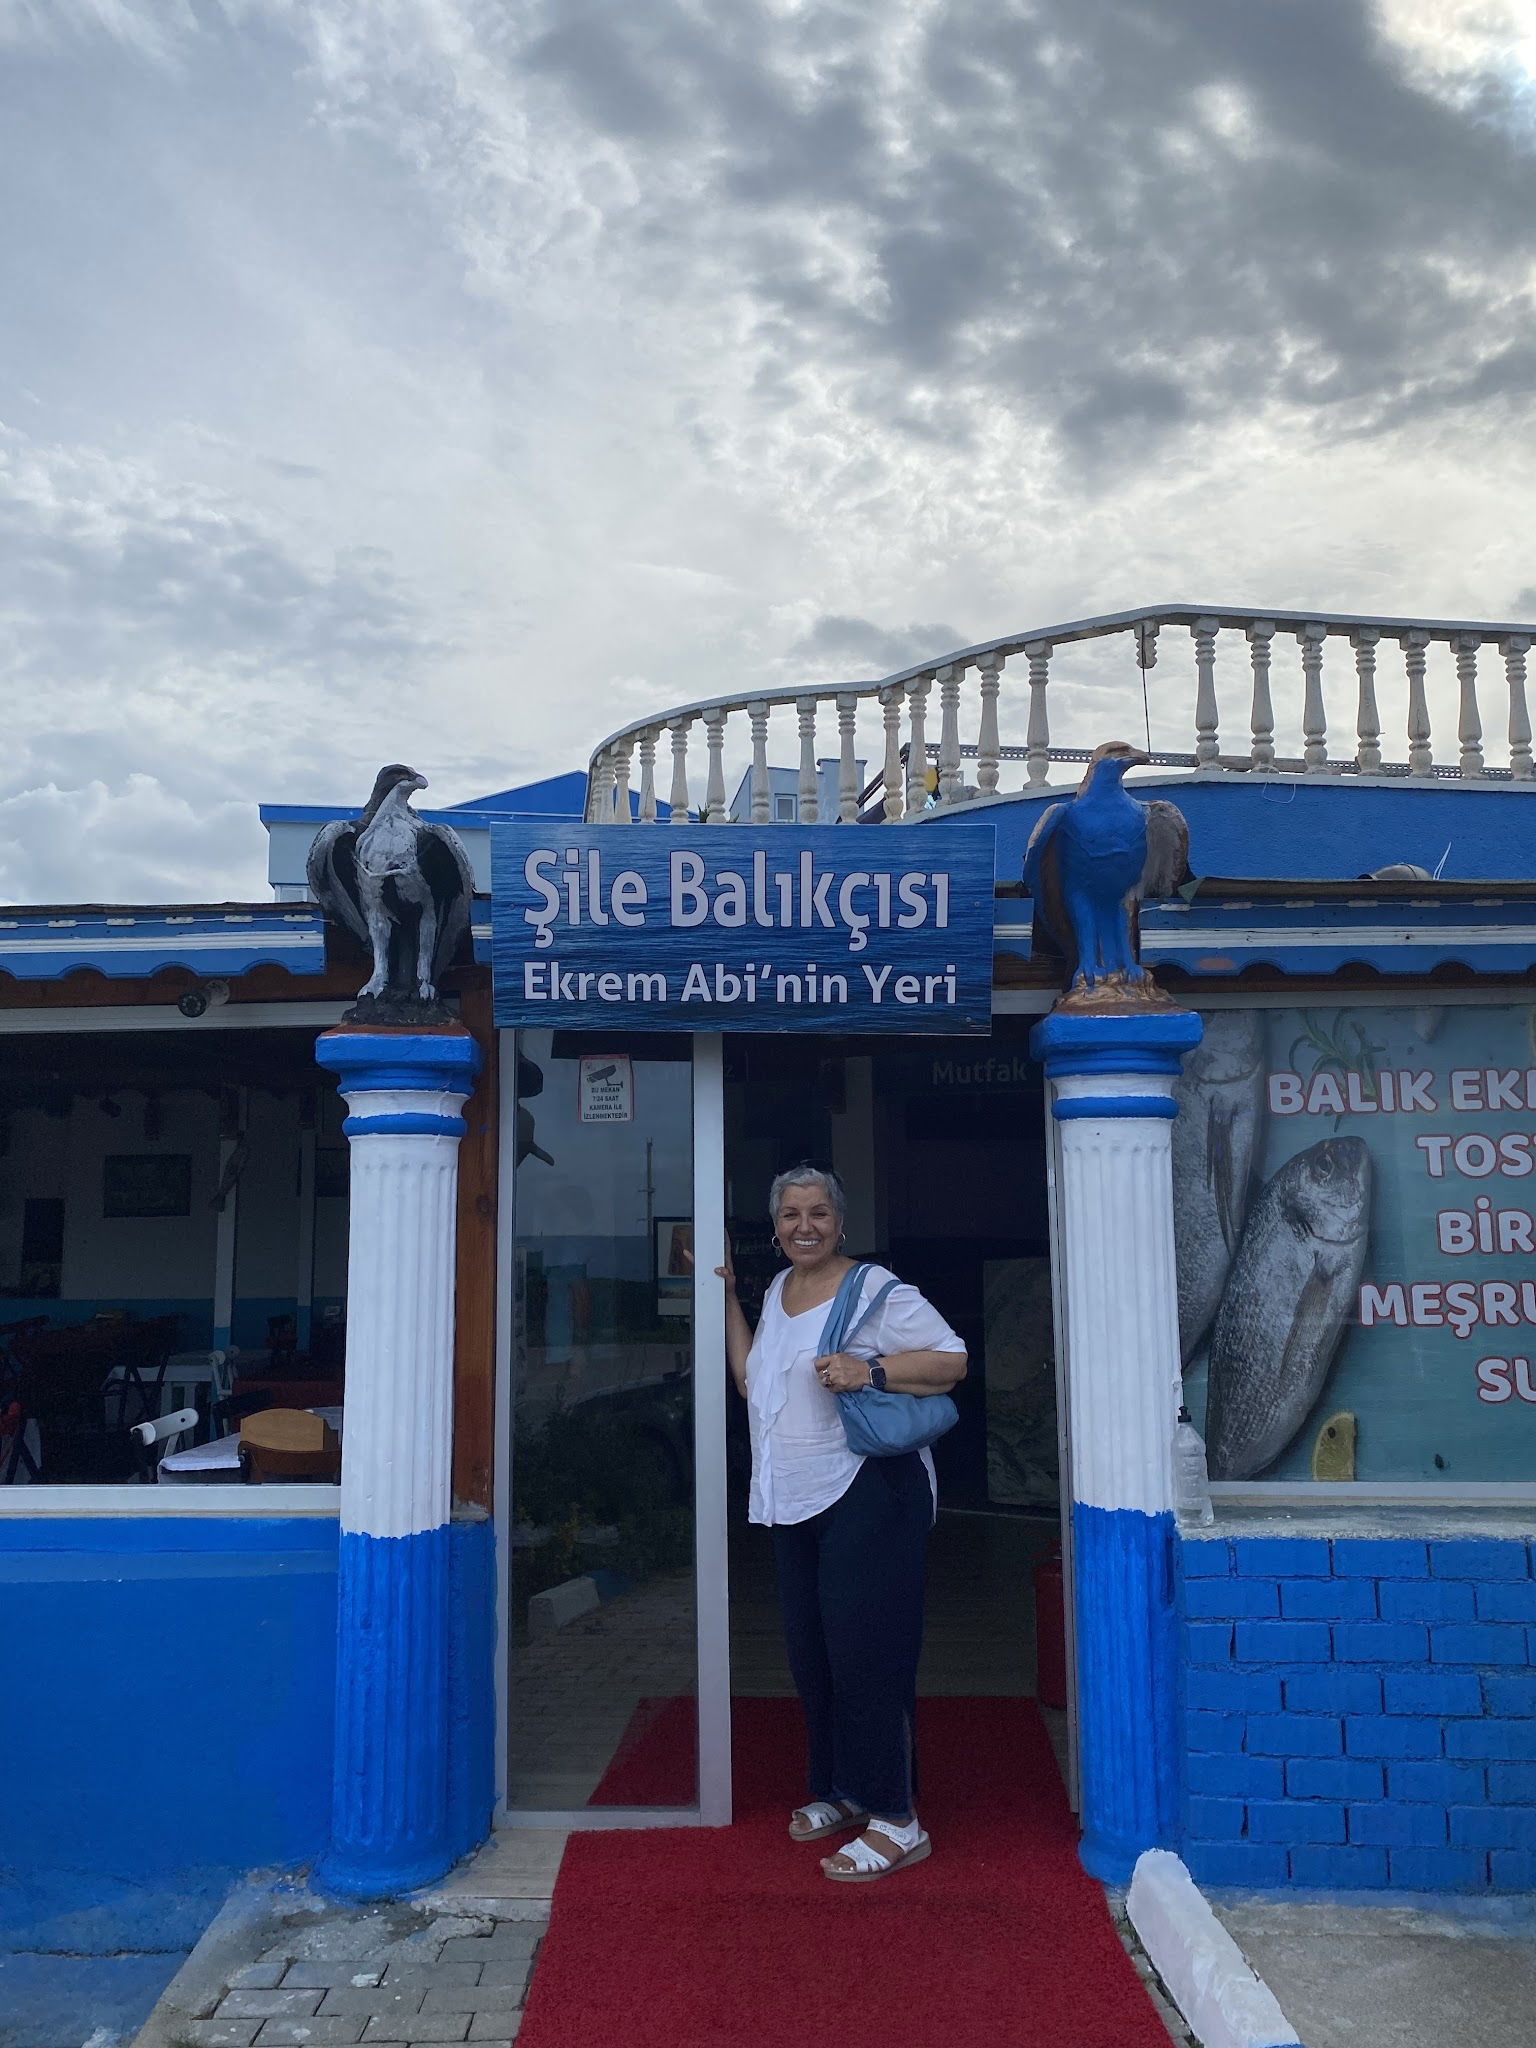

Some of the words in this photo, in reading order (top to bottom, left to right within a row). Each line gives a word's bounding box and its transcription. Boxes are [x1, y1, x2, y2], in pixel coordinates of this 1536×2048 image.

[523, 848, 649, 949] Şile
[669, 850, 950, 951] Balıkçısı
[524, 961, 667, 1002] Ekrem
[680, 963, 848, 1003] Abi’nin
[862, 964, 956, 1004] Yeri
[932, 1057, 1028, 1085] Mutfak
[1267, 1069, 1438, 1115] BALIK
[1451, 1069, 1536, 1111] EK
[1416, 1133, 1536, 1178] TOS
